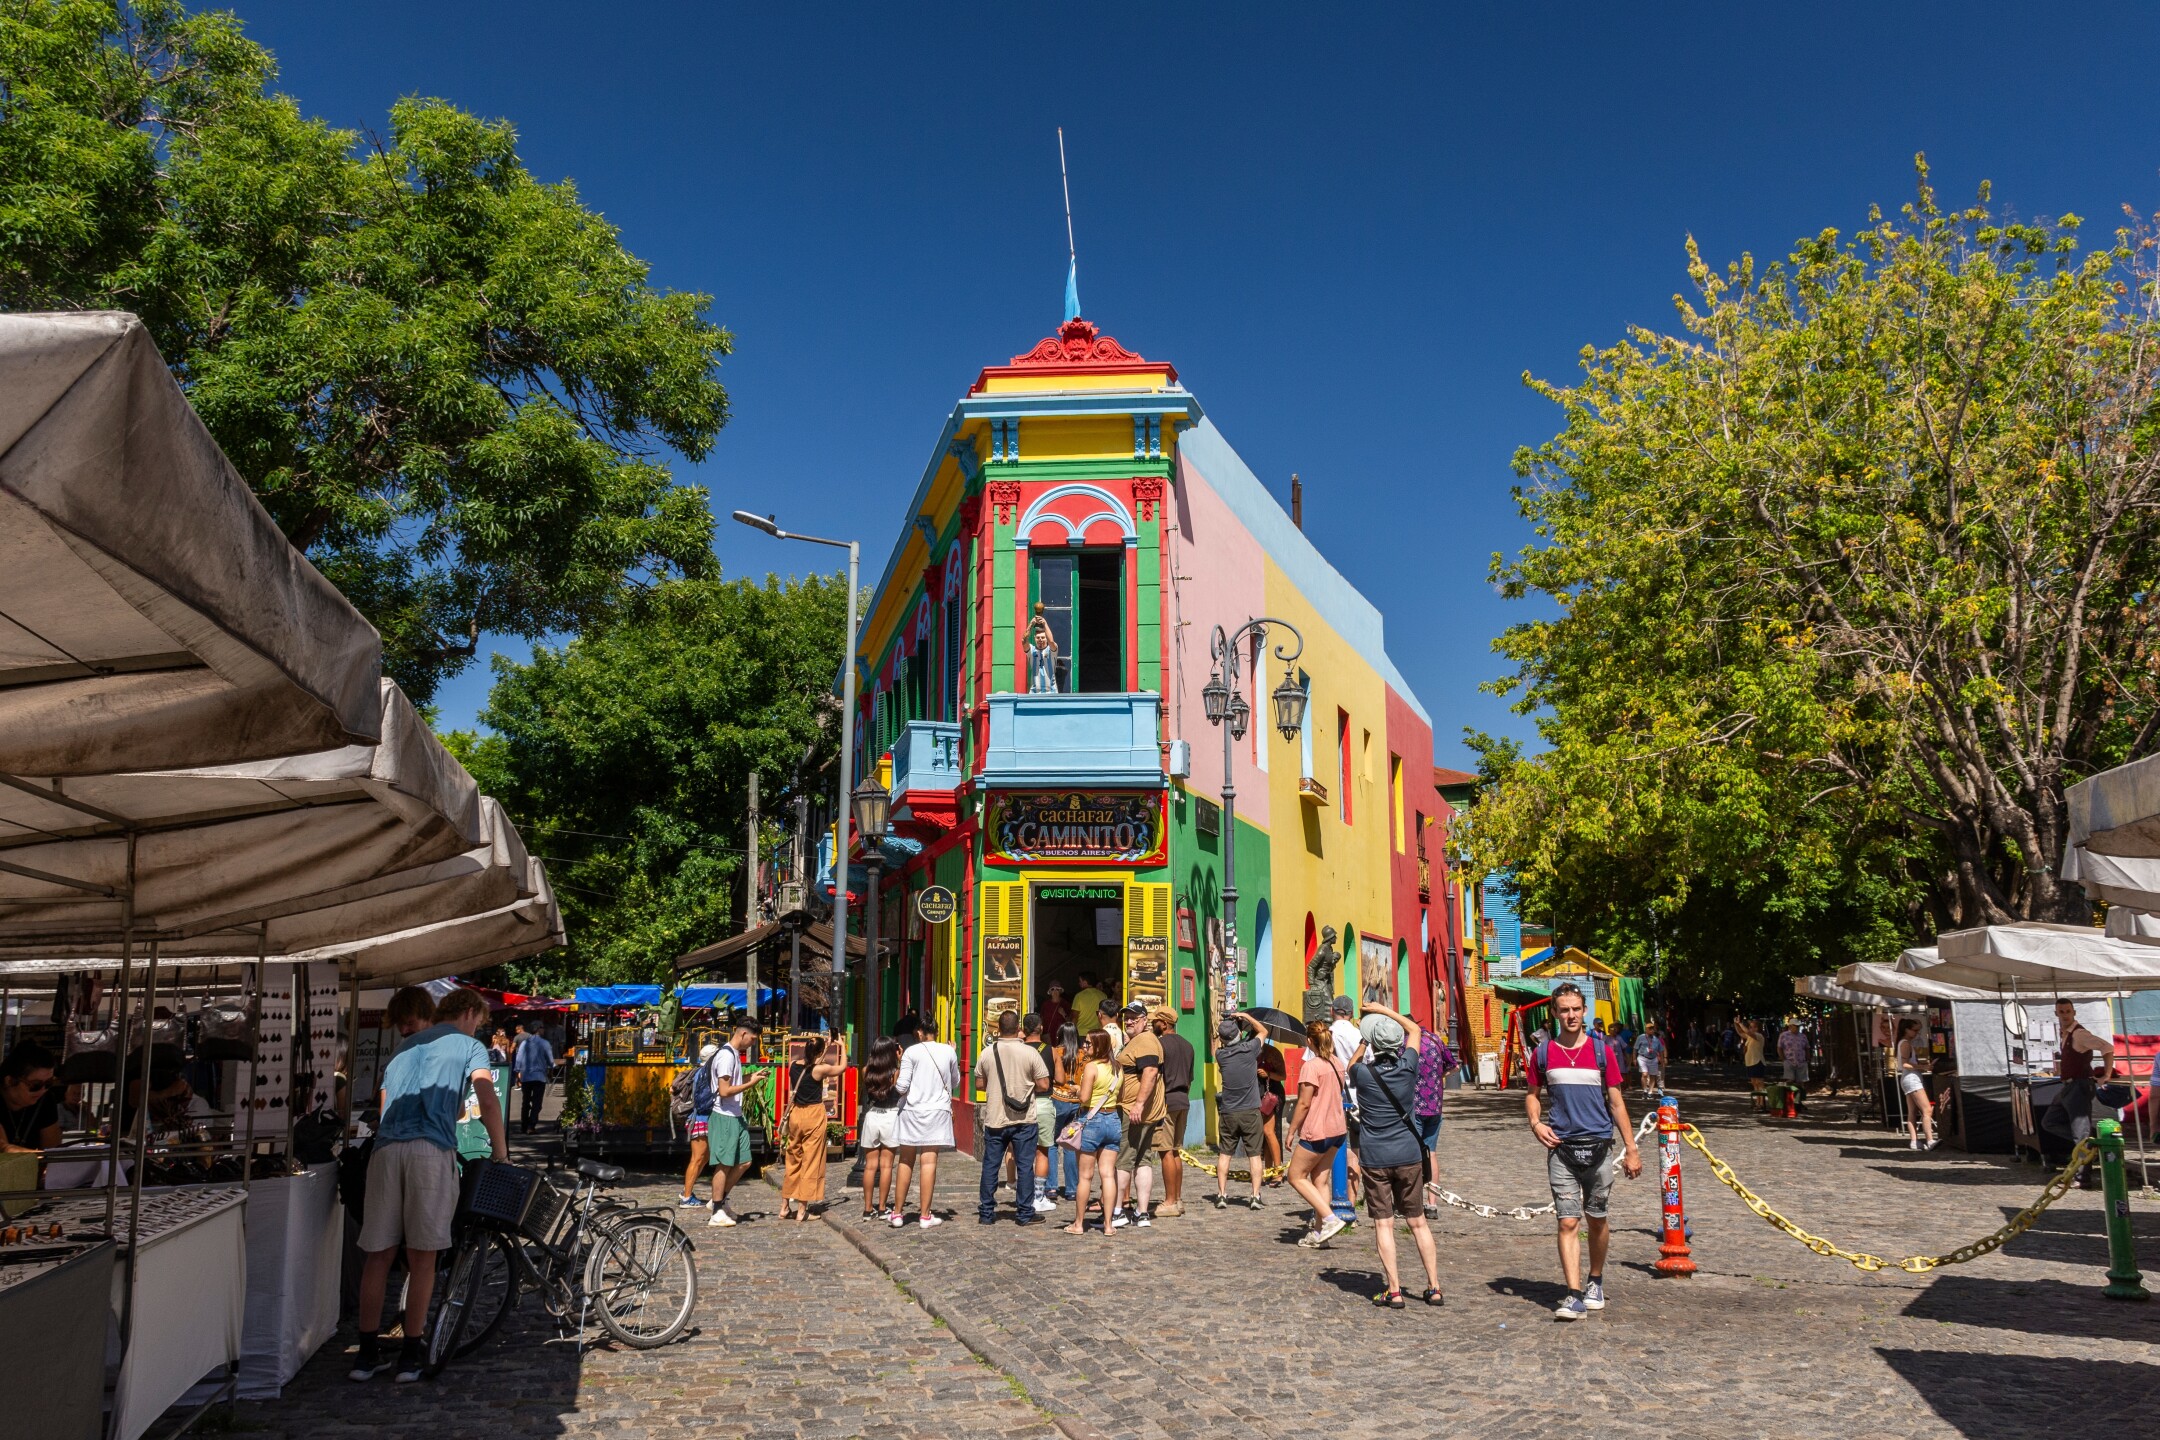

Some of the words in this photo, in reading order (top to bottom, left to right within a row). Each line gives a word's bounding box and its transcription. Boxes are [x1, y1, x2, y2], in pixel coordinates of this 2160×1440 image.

[1018, 822, 1135, 850] CAMINITO
[1040, 888, 1117, 899] @VISITCAMINITO
[987, 942, 1020, 950] ALFAJOR
[1131, 943, 1165, 951] ALFAJOR
